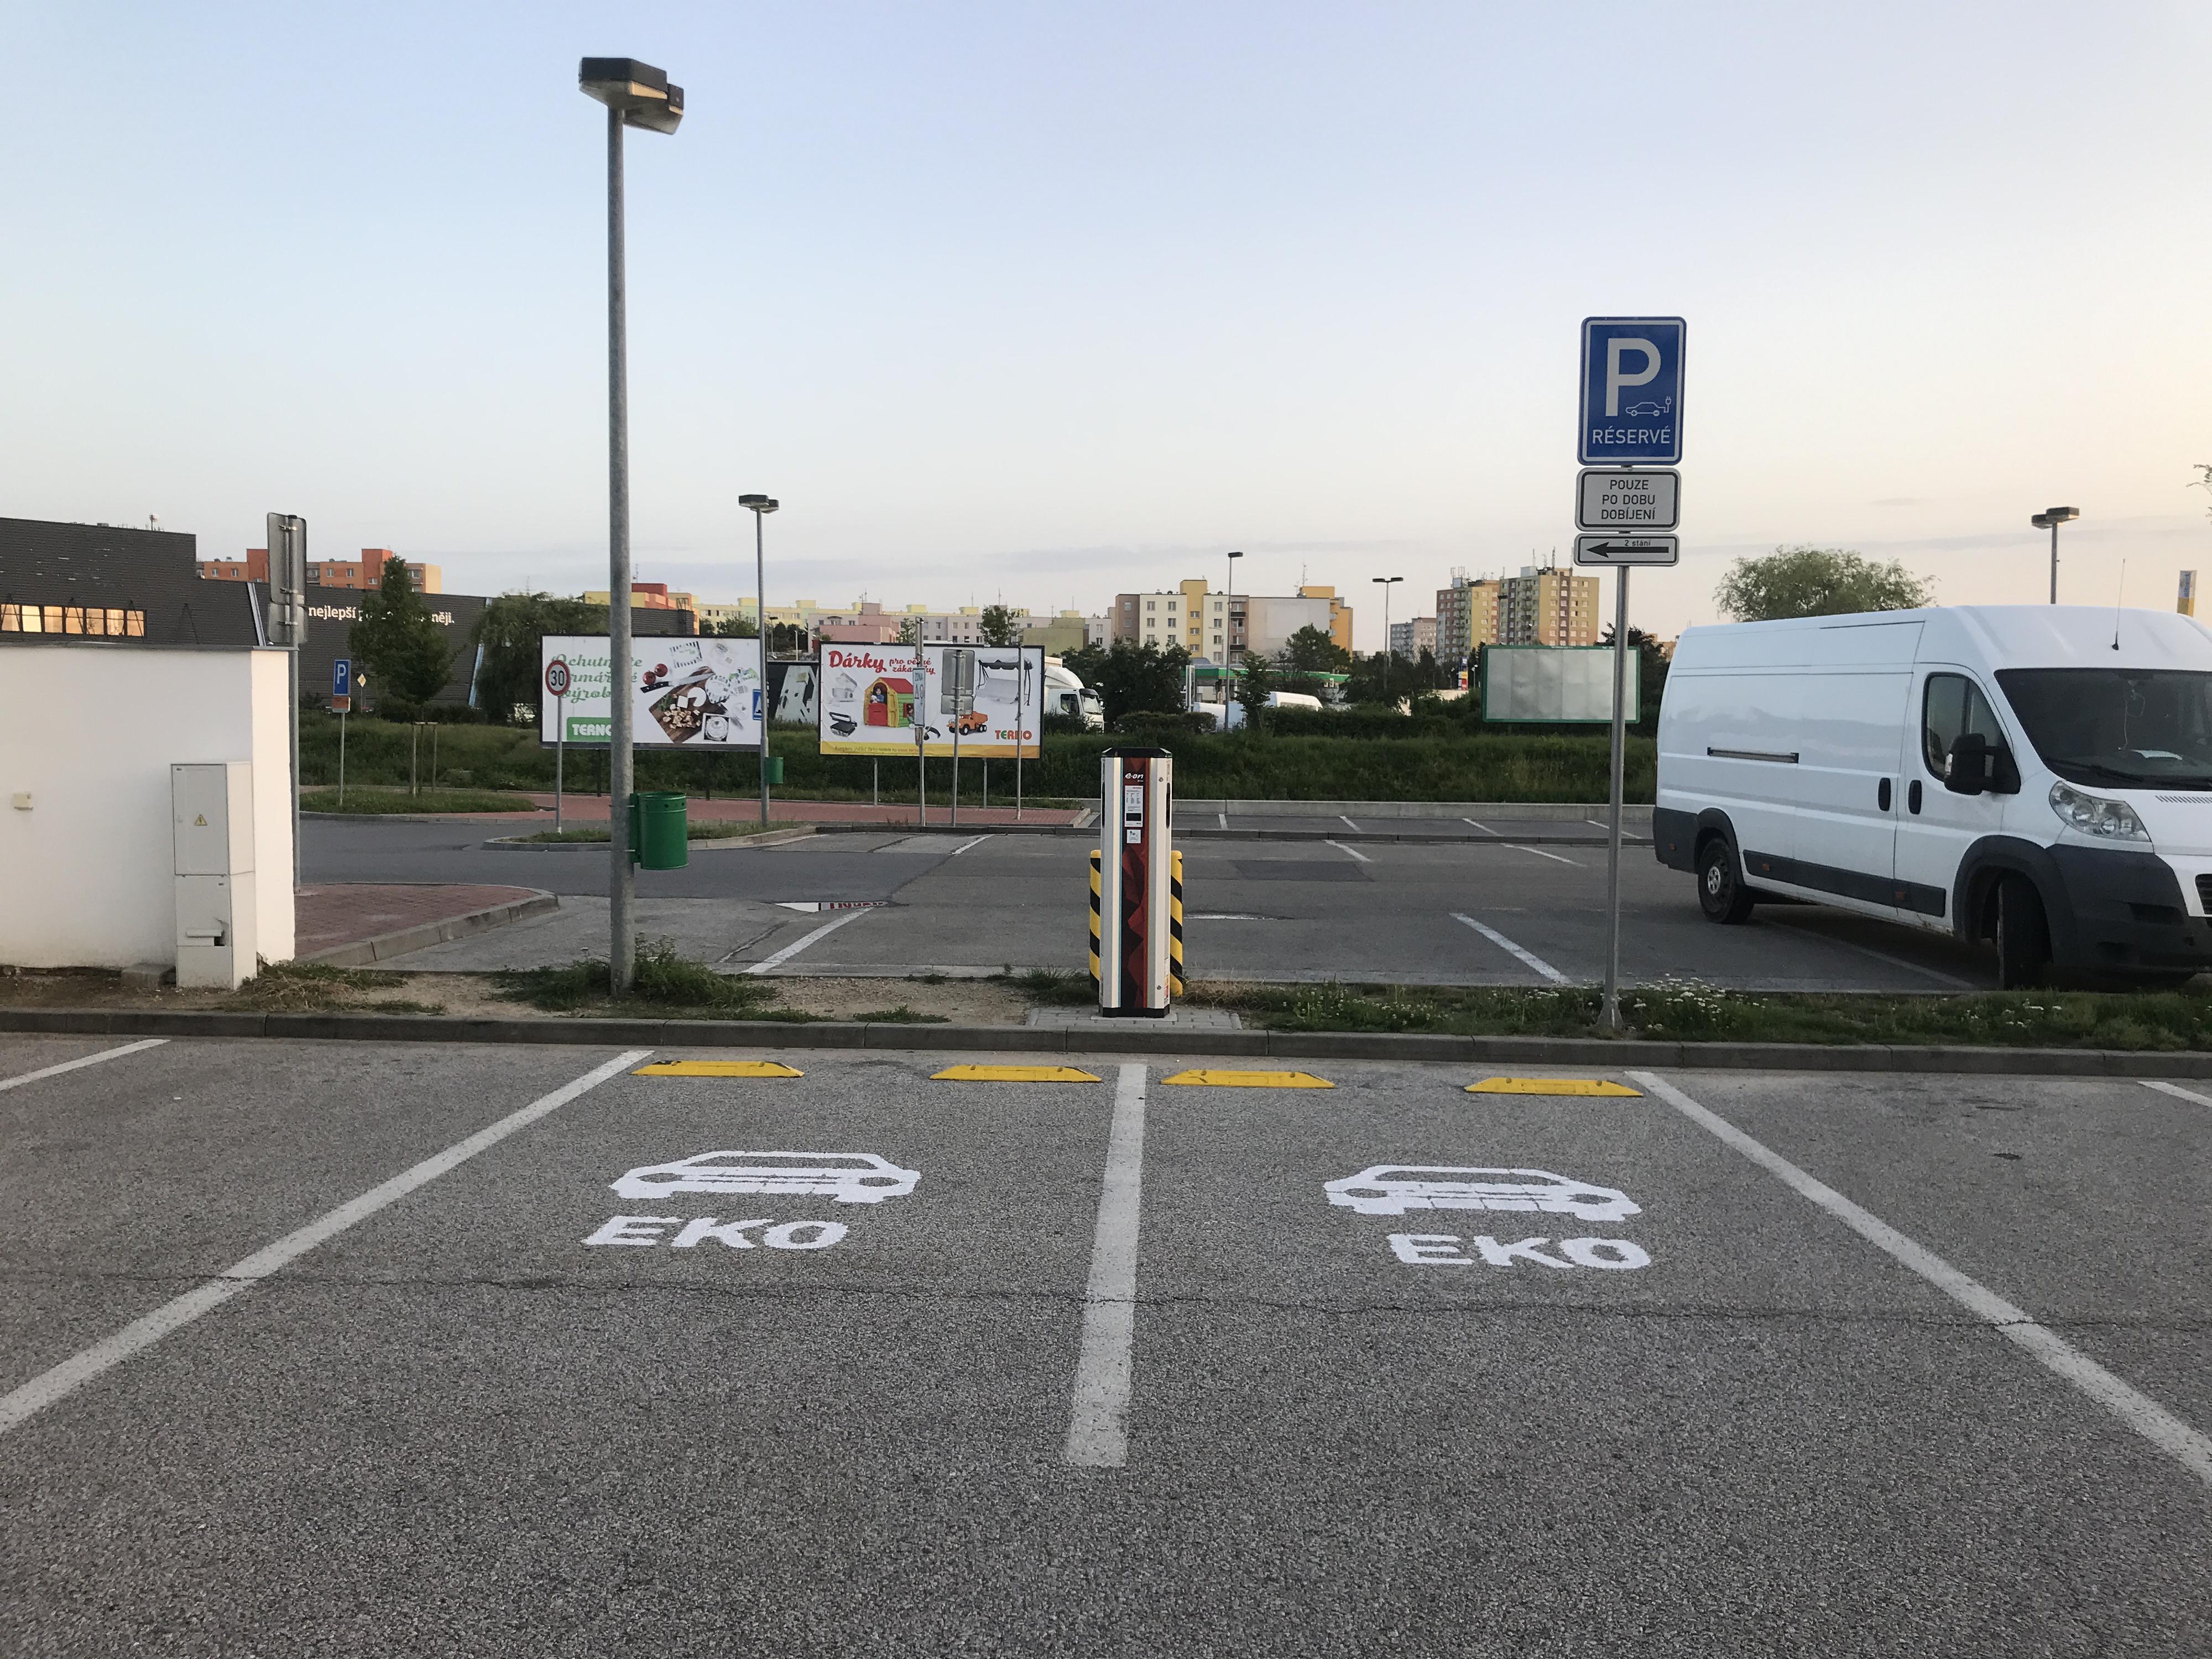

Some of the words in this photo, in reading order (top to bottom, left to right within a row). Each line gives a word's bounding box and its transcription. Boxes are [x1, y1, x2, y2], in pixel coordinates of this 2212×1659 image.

[1605, 338, 1661, 416] P
[1592, 425, 1671, 444] RÉSERVÉ
[1610, 479, 1649, 490] POUZE
[1602, 494, 1618, 505] PO
[1623, 494, 1655, 505] DOBU
[1601, 507, 1656, 520] DOBÍJENÍ
[308, 605, 356, 620] nejlepší
[828, 650, 887, 673] Dárky
[889, 658, 905, 667] pro
[337, 664, 347, 684] P
[550, 670, 565, 686] 30
[581, 1216, 849, 1249] EKO
[1386, 1234, 1651, 1269] EKO
